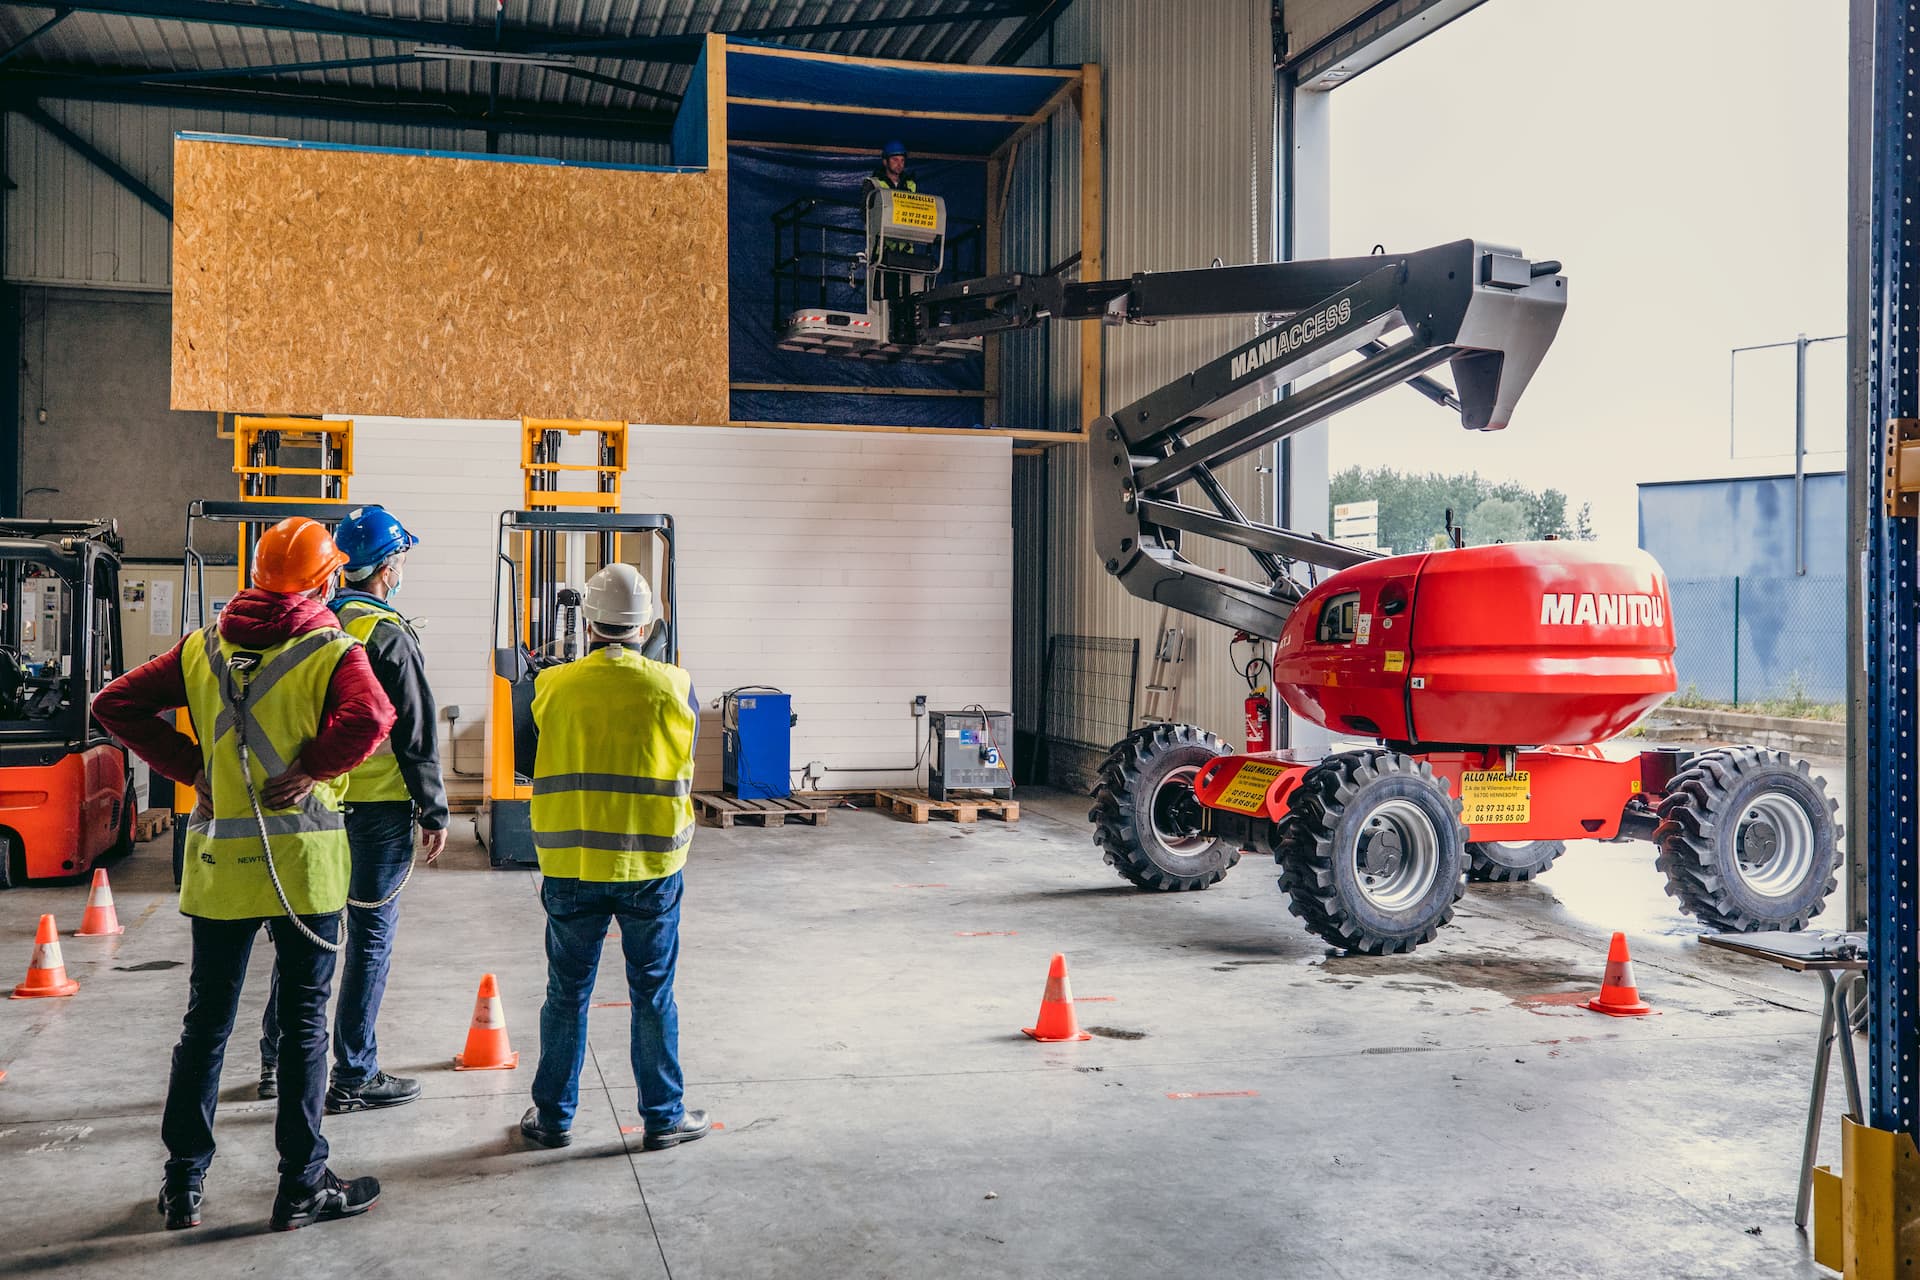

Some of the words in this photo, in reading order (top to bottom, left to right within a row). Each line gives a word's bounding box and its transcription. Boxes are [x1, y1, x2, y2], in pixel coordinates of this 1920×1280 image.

[1232, 298, 1351, 381] MANIACCESS
[1540, 593, 1664, 627] MANITOU
[1464, 773, 1485, 782] ALLO
[1486, 773, 1529, 782] NACLES
[238, 856, 273, 864] NEWTO
